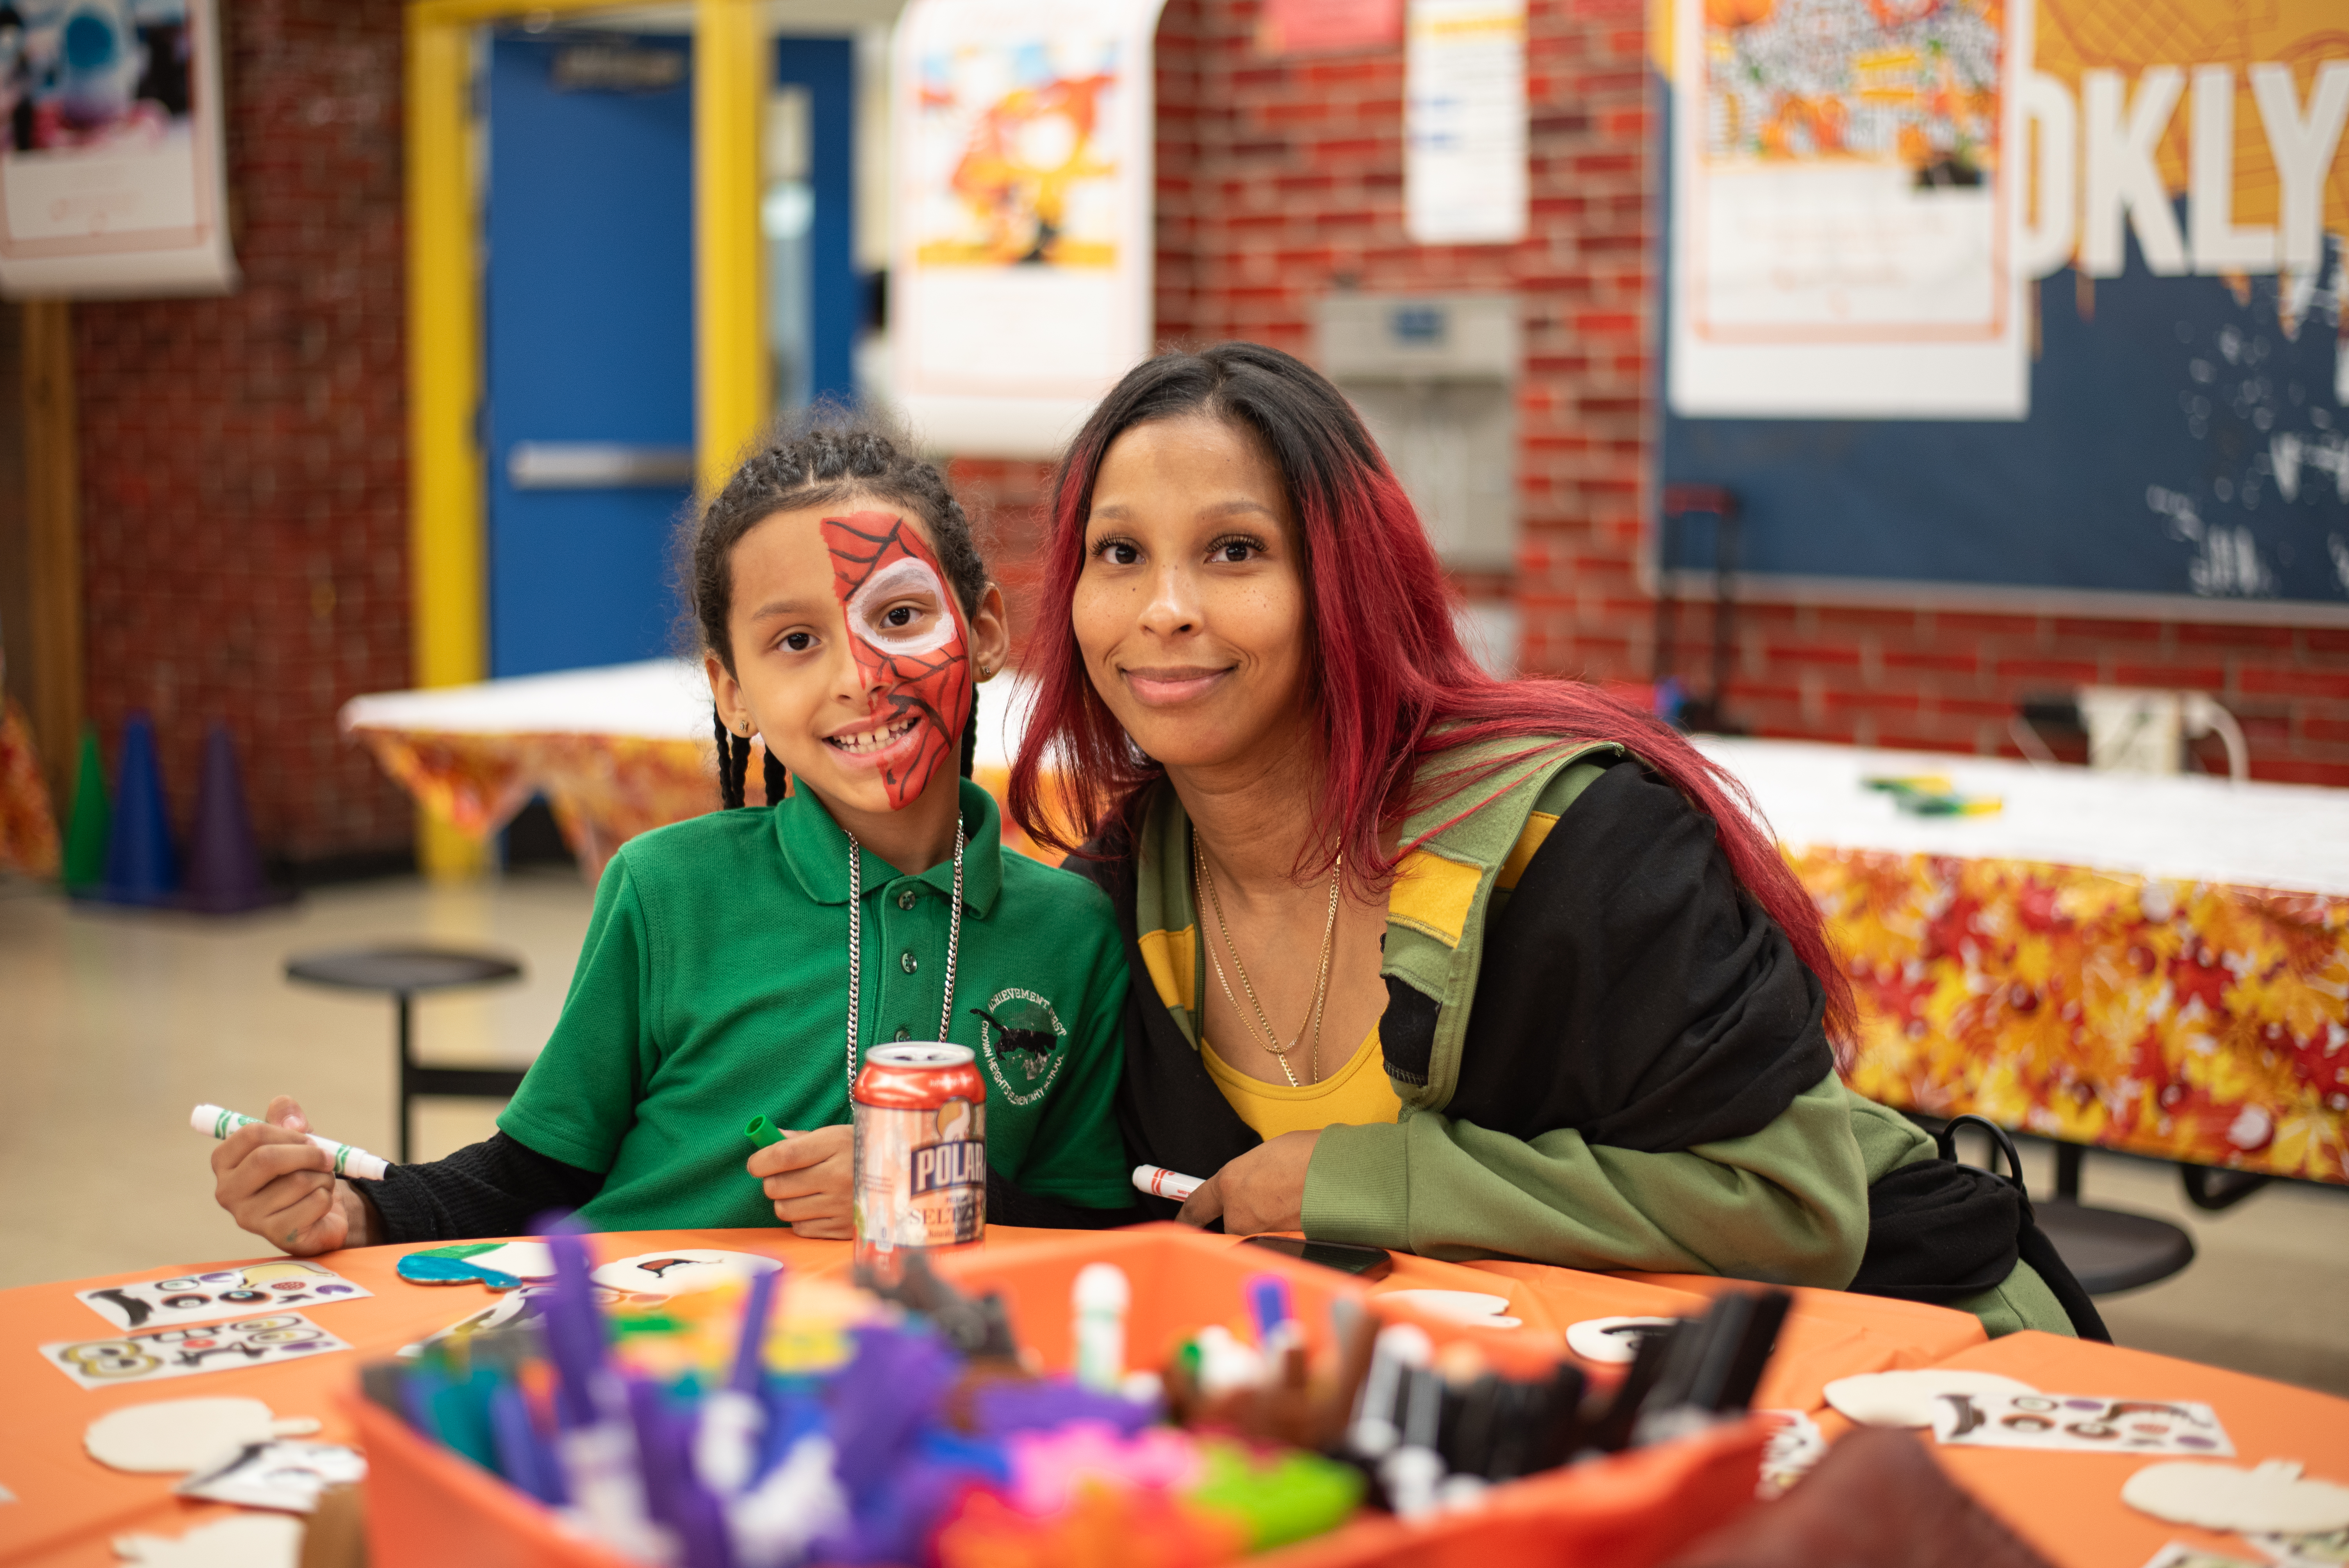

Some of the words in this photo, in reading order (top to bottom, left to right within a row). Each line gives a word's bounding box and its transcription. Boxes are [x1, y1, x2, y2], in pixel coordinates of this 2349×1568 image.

[1048, 1007, 1067, 1036] FRST
[981, 1020, 993, 1057] CROWN
[987, 1057, 1012, 1095] HEIGHTS
[916, 1141, 984, 1192] POLAR
[929, 1228, 954, 1238] Naturally
